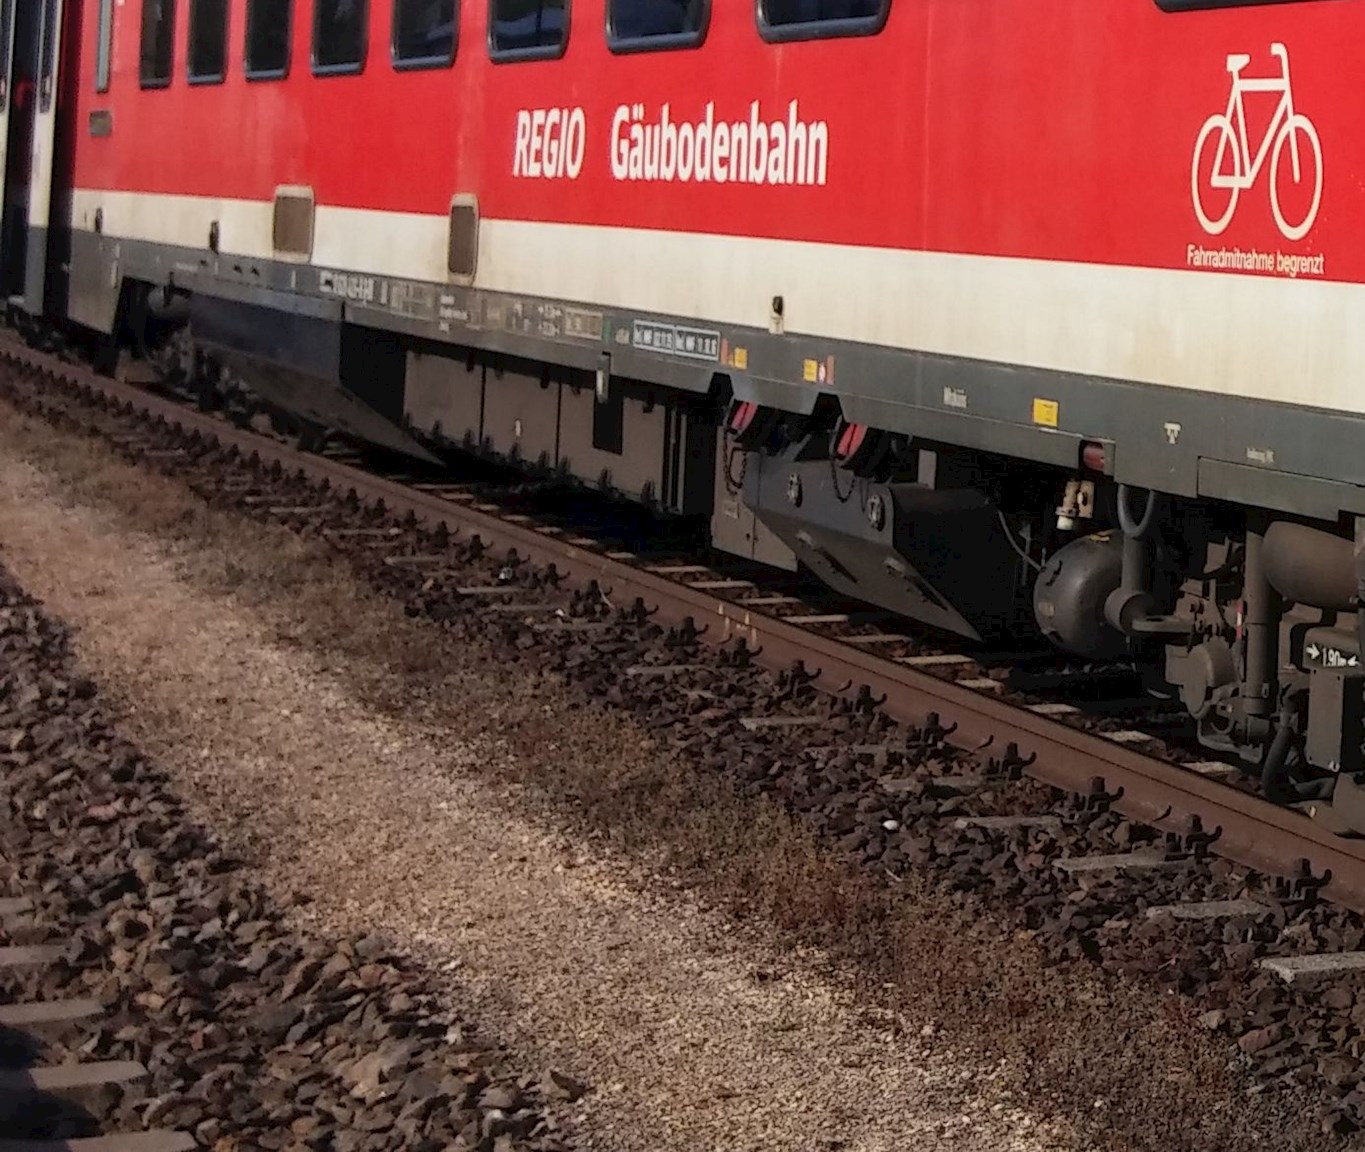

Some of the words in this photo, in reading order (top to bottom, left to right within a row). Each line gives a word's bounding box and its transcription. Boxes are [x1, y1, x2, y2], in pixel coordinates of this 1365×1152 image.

[513, 107, 586, 179] REGIO
[611, 99, 828, 185] Gäubodenbahn
[1186, 244, 1275, 272] Fahrradmitnahme
[1276, 250, 1325, 278] begrenzt
